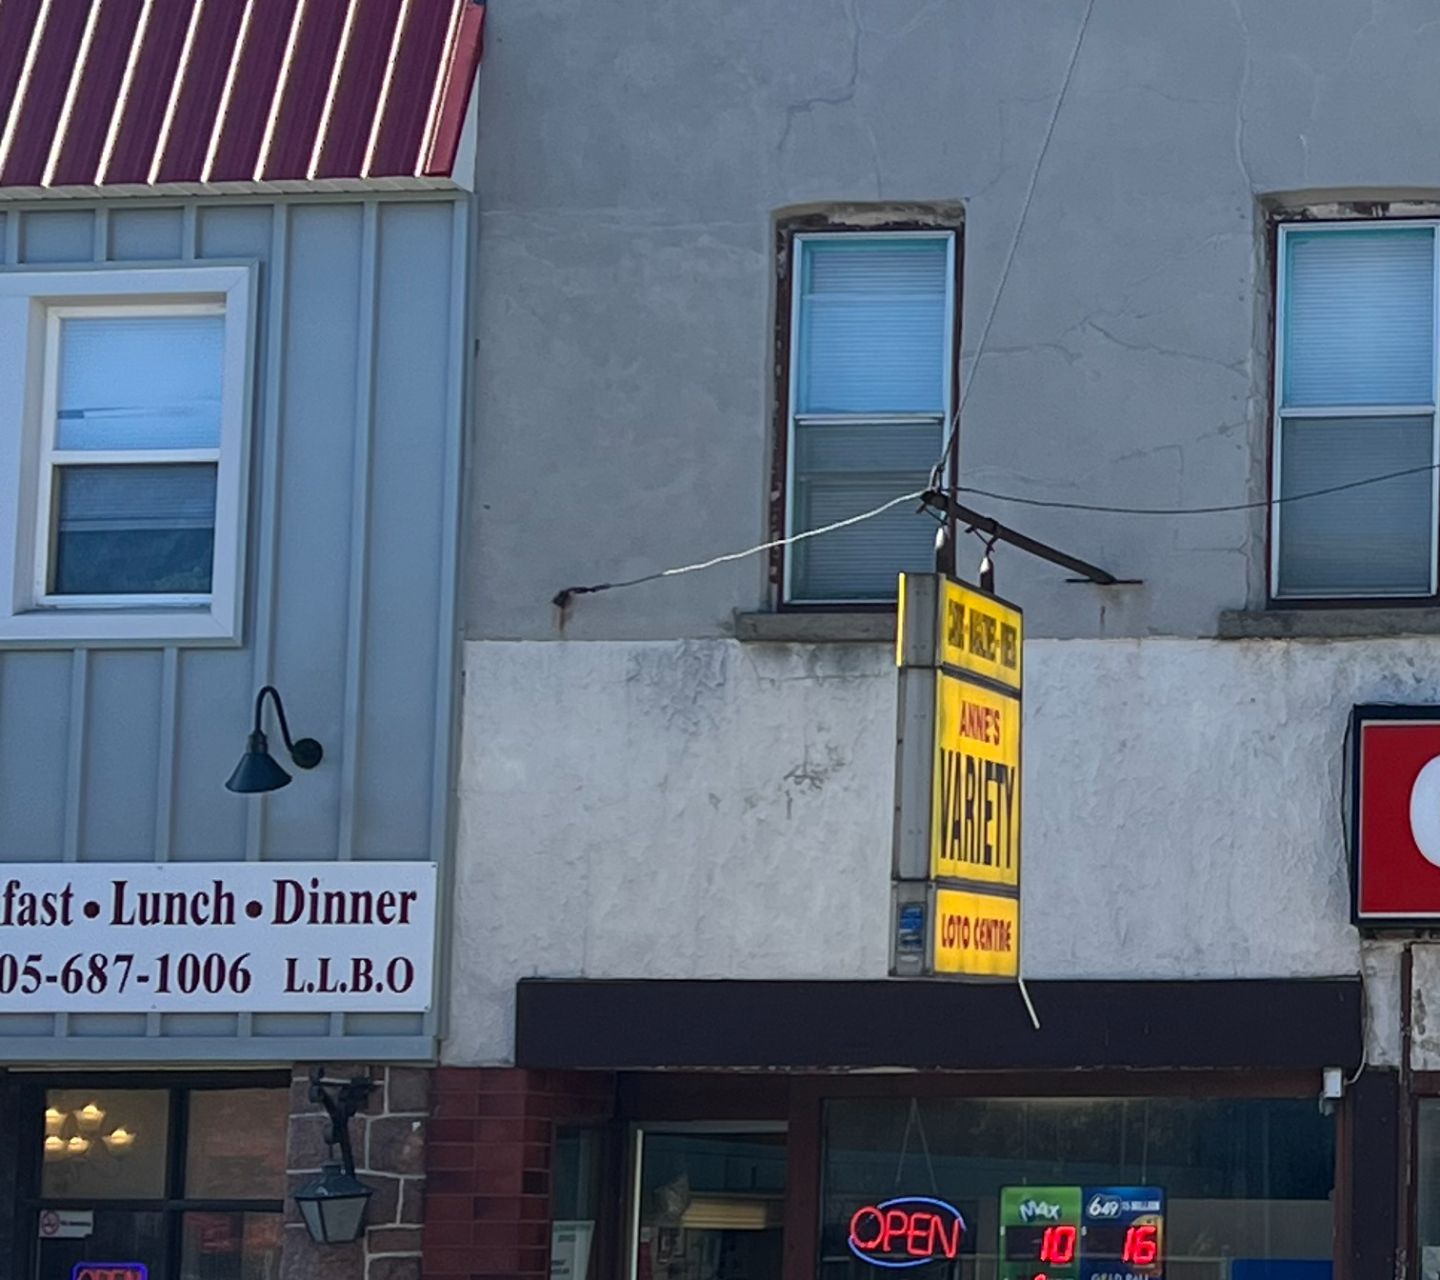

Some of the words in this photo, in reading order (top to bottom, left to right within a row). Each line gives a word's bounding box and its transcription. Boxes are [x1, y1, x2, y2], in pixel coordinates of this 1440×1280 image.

[959, 700, 1001, 746] ANNE'S
[940, 746, 1016, 870] VARIETY
[110, 879, 236, 926] Lunch
[271, 877, 418, 925] Dinner
[941, 913, 971, 950] LOTO
[283, 956, 415, 994] L.L.B.O
[849, 1206, 961, 1259] OPEN
[1041, 1225, 1077, 1264] 10
[1122, 1224, 1157, 1264] 16
